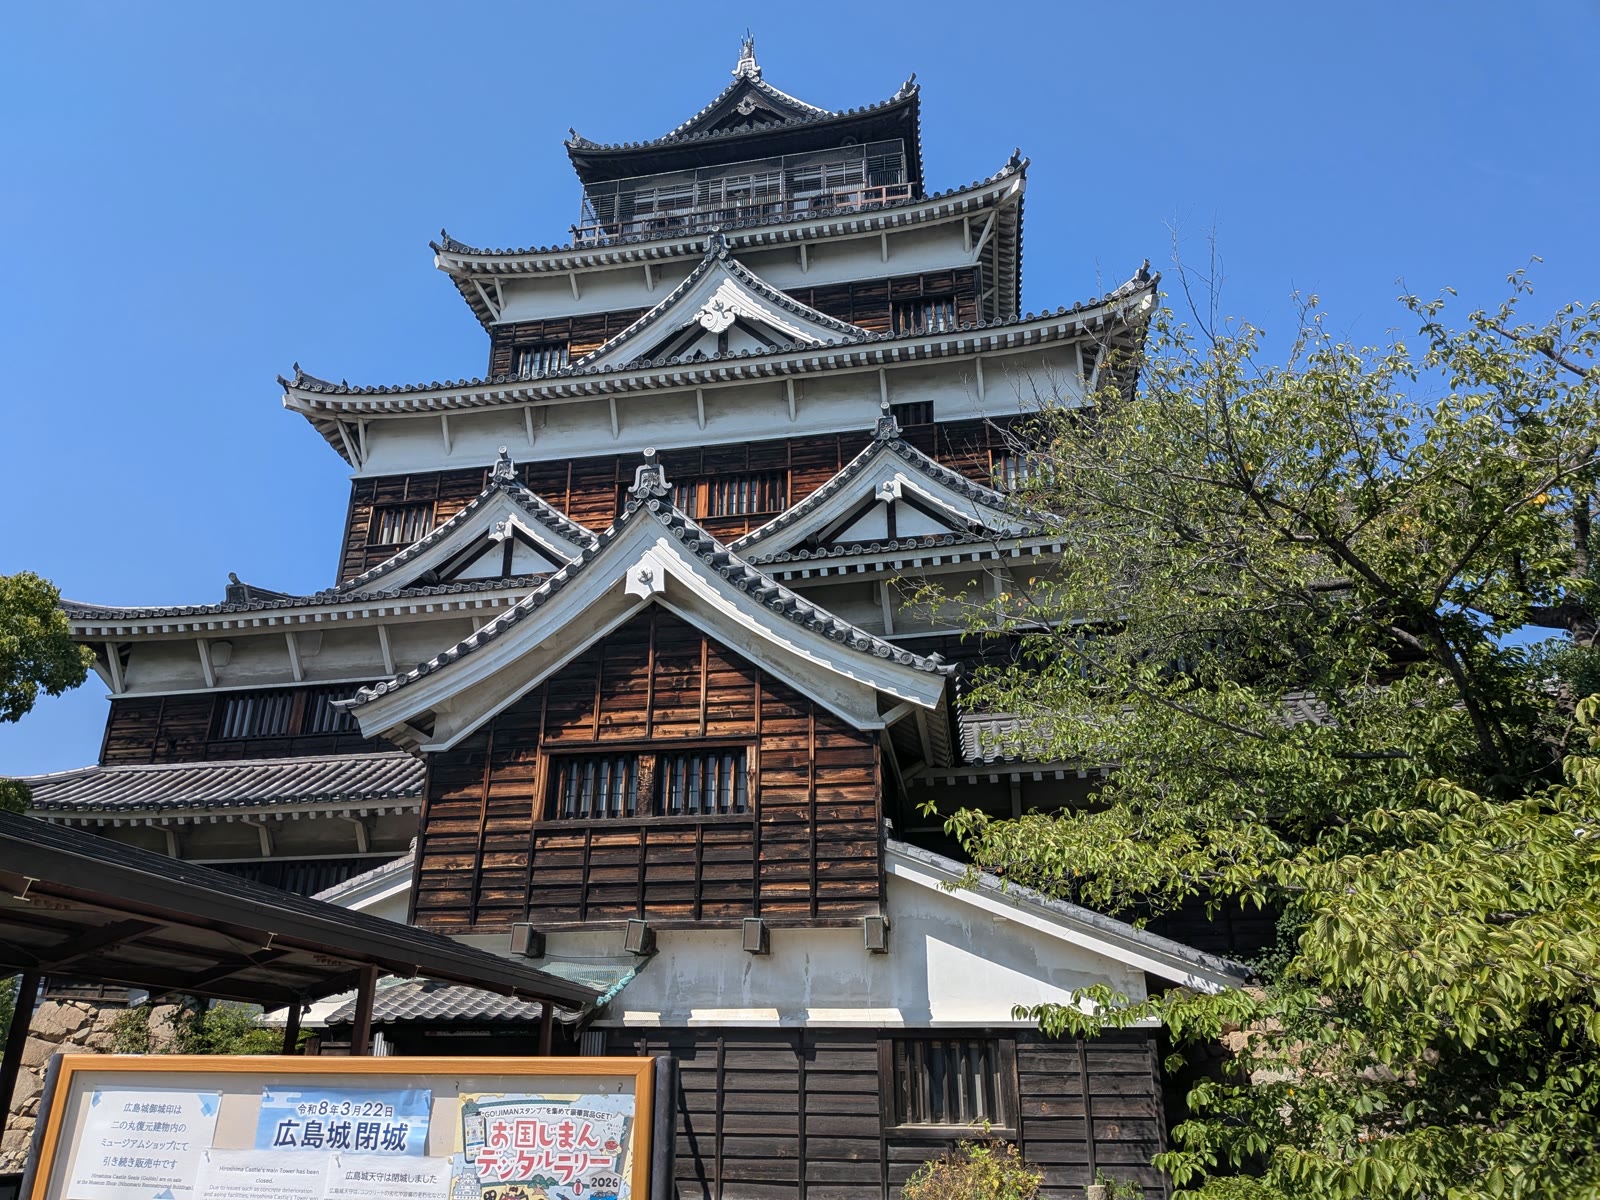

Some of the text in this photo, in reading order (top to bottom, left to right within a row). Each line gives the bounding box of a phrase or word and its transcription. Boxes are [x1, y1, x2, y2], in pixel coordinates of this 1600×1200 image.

[123, 1102, 182, 1115] 広島城御城印は
[298, 1101, 393, 1117] 令和8年3月22日
[111, 1120, 187, 1133] 二の丸復元建物内の
[273, 1119, 409, 1151] 広島城閉城
[490, 1120, 598, 1148] お国じまん
[101, 1138, 189, 1151] ミュージアムショップにて
[103, 1156, 178, 1170] 引き続き販売中です
[477, 1149, 610, 1183] デジタルラリー
[345, 1171, 437, 1184] 広島城天守は閉城しました
[591, 1177, 618, 1188] 2026
